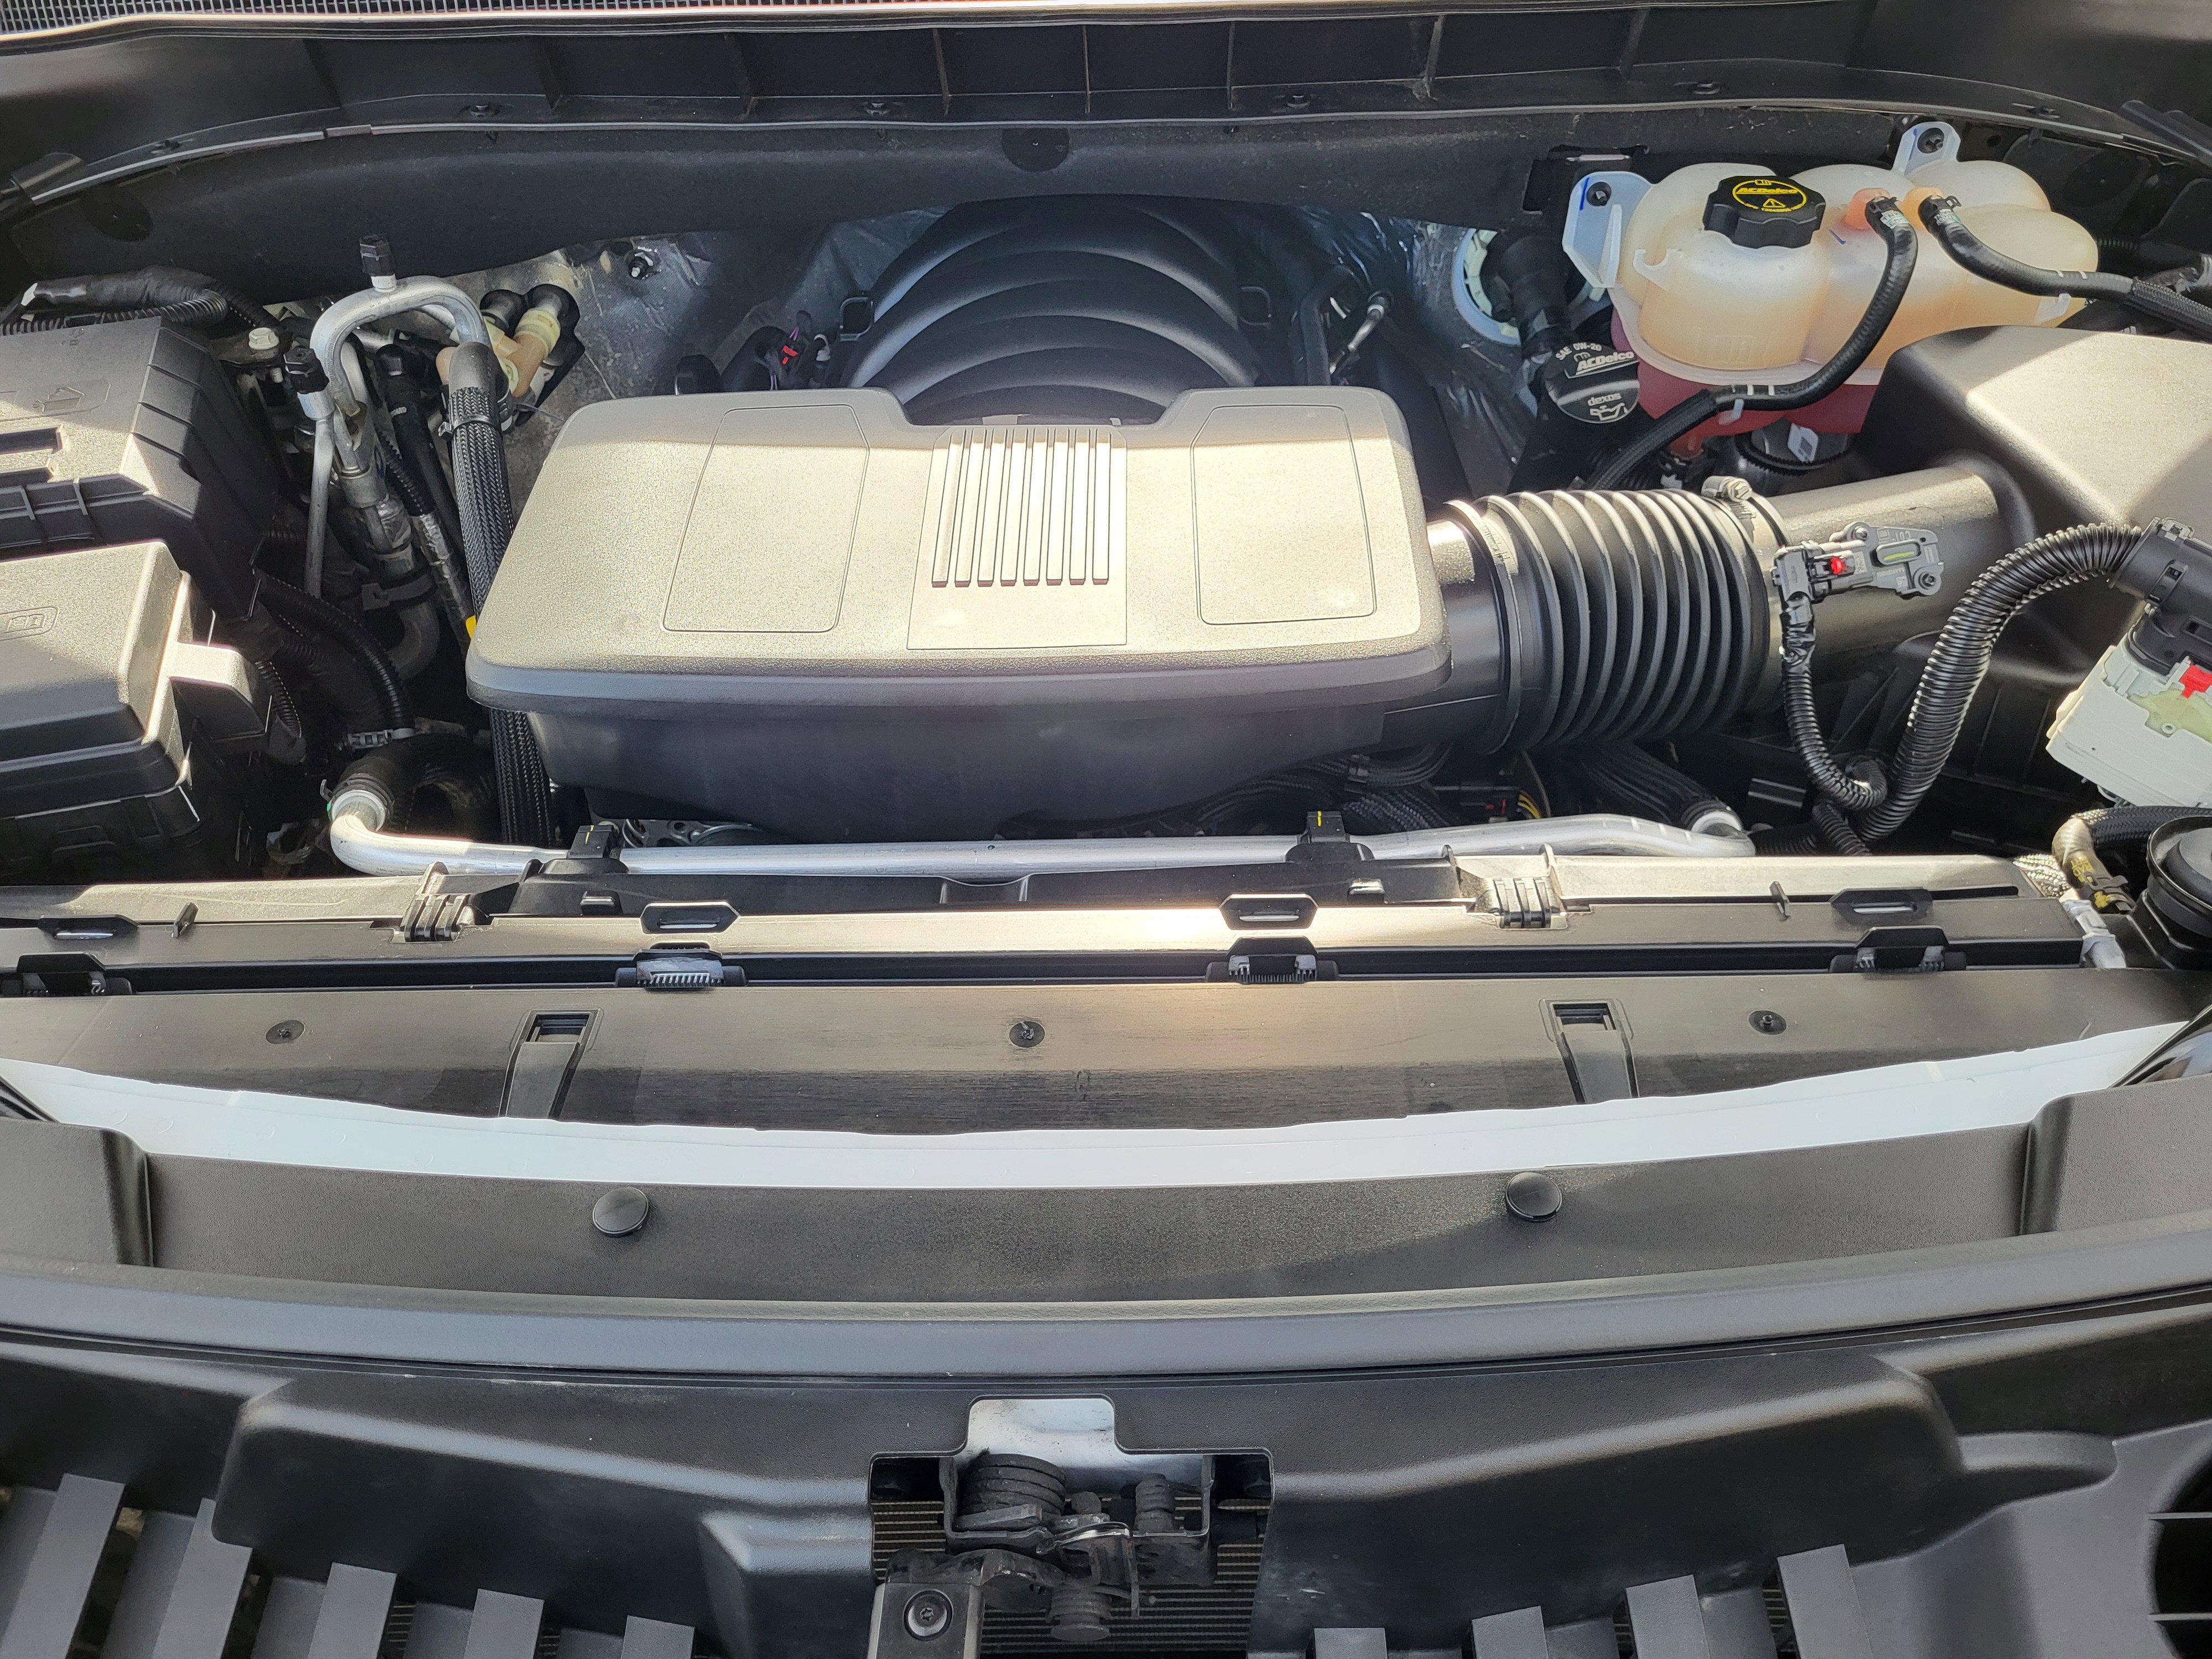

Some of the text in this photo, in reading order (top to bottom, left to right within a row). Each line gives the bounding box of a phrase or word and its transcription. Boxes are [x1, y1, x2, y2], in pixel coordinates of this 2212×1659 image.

[1555, 342, 1602, 361] SAE 0W-20
[1577, 351, 1635, 371] ACDelco
[1587, 393, 1622, 406] dexos
